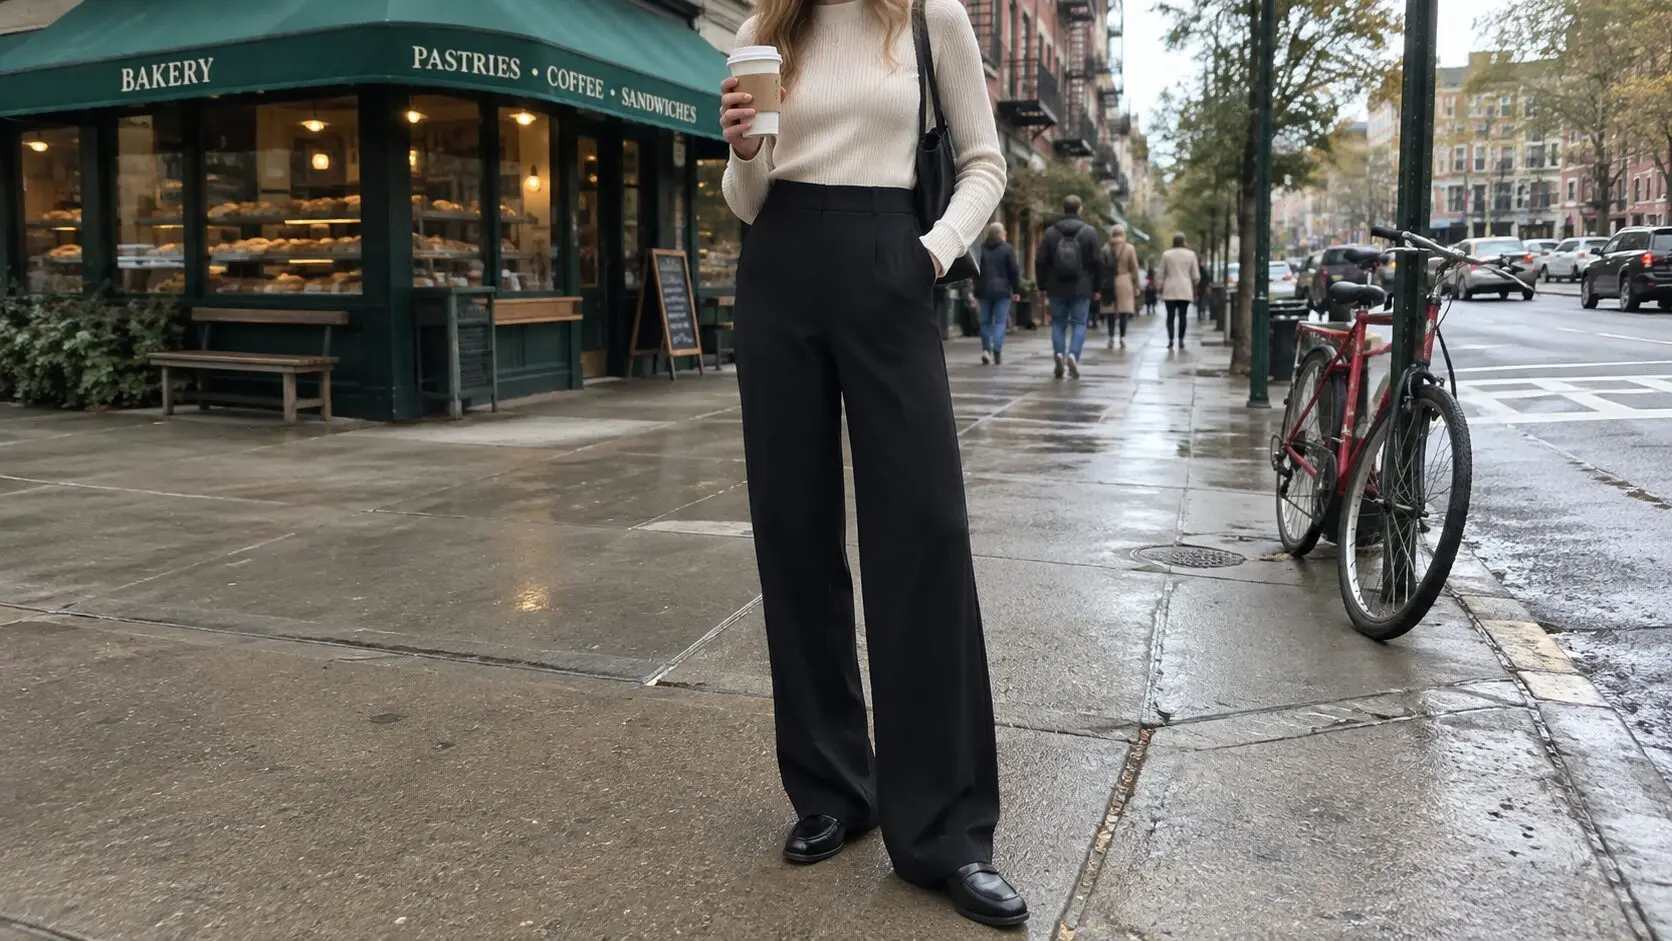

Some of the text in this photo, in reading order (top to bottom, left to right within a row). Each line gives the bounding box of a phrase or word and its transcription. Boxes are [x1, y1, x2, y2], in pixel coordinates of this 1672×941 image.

[121, 57, 214, 92] BAKERY
[412, 45, 697, 123] PASTRIES COFFEE SANDWICHES
